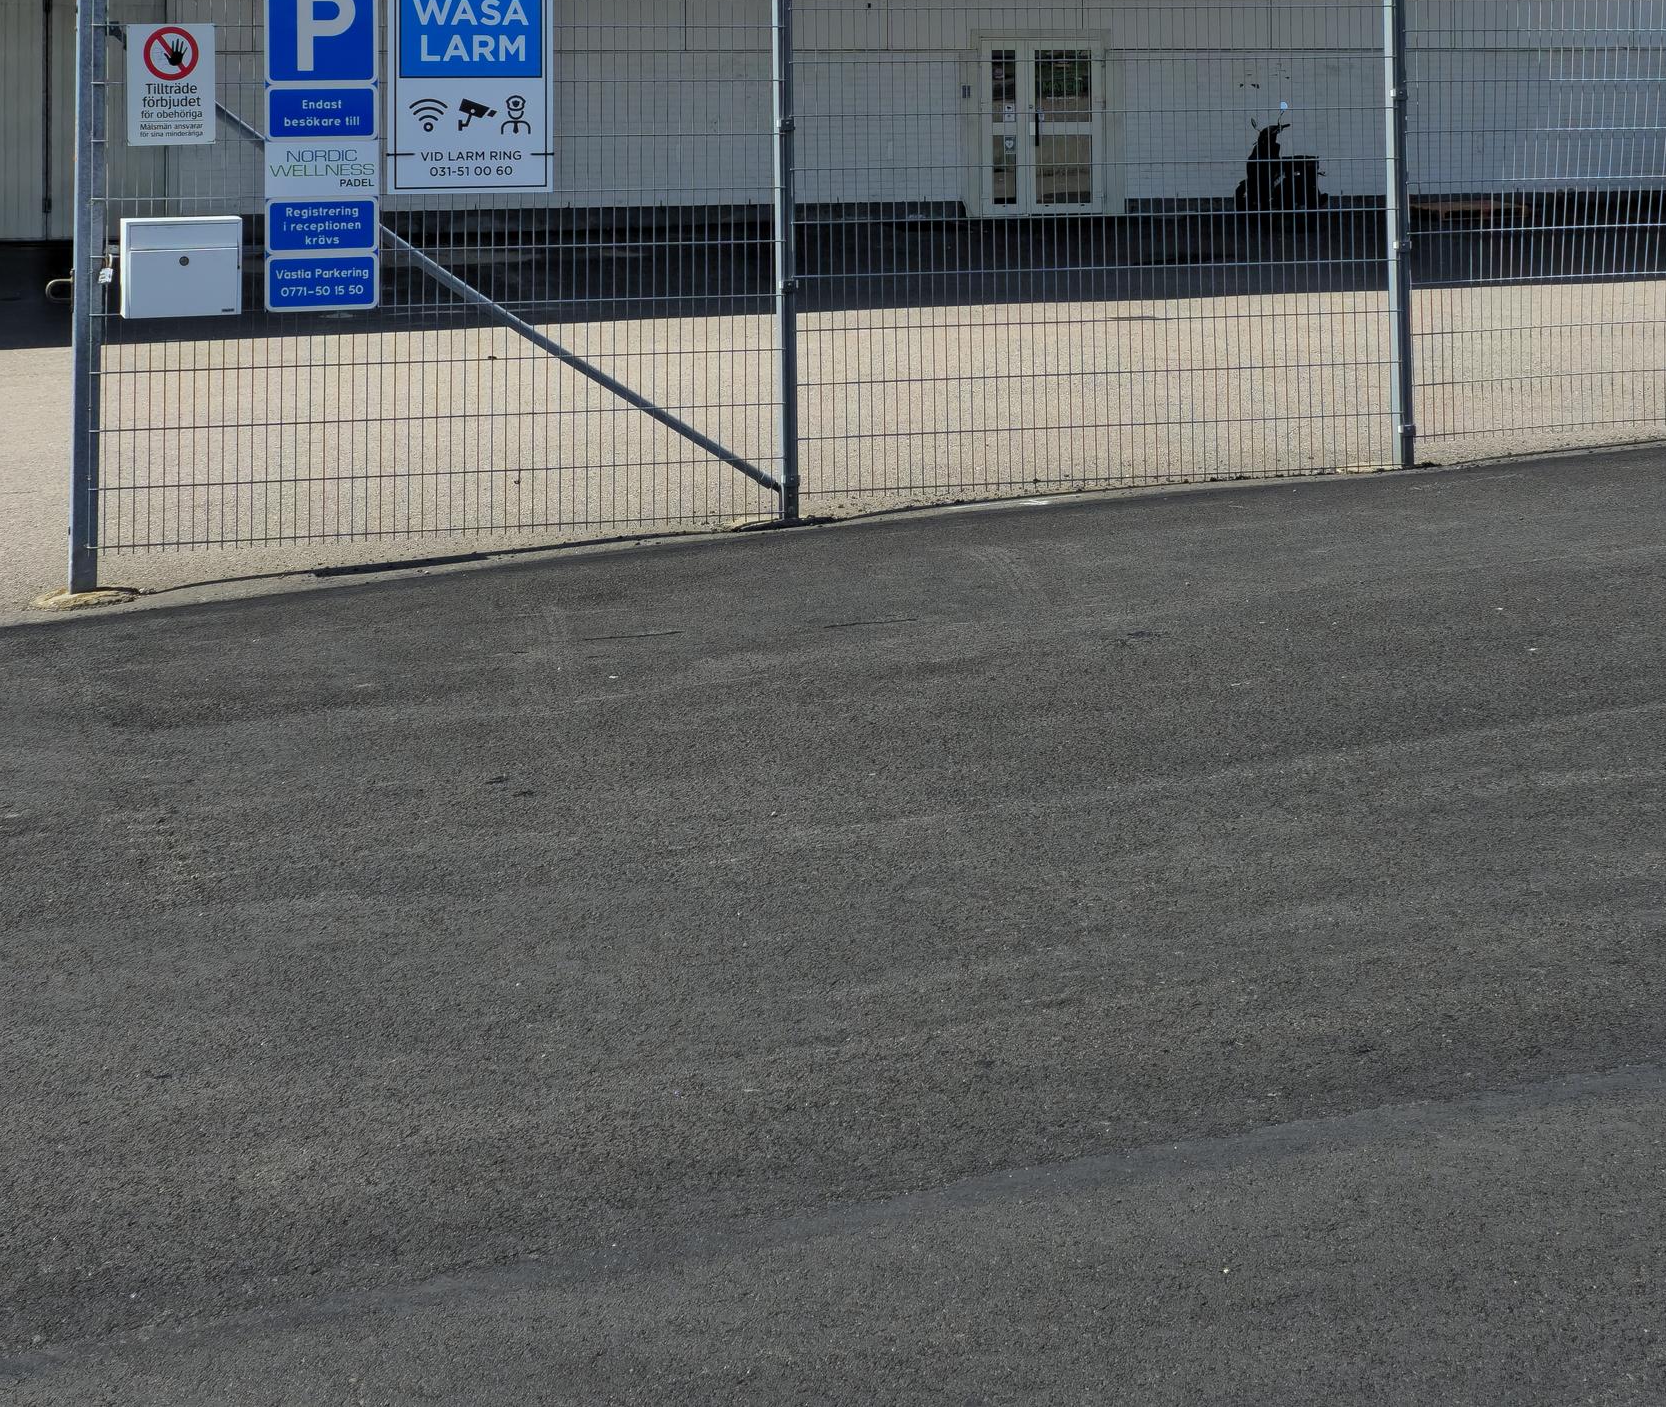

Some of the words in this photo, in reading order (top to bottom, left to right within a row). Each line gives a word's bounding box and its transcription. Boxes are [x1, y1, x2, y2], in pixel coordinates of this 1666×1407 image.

[420, 34, 526, 62] LARM
[145, 82, 198, 95] Tillträde
[142, 96, 202, 110] förbjudet
[302, 99, 342, 110] Endast
[141, 110, 154, 119] för
[156, 109, 203, 120] obehöriga
[284, 116, 341, 127] besökare
[345, 115, 360, 126] till
[140, 122, 172, 131] Målsmän
[174, 122, 204, 131] ansvarar
[286, 149, 358, 163] NORDIC
[420, 151, 444, 162] VID
[448, 151, 485, 162] LARM
[489, 150, 522, 161] RING
[269, 163, 375, 177] WELLNESS
[429, 166, 470, 177] 031-51
[474, 166, 492, 176] 00
[496, 165, 513, 176] 60
[339, 178, 375, 188] PADEL
[285, 205, 359, 219] Registrering
[283, 221, 287, 232] i
[290, 220, 362, 233] receptionen
[305, 235, 340, 245] krävs
[315, 267, 370, 280] Parkering
[280, 285, 331, 297] 0771-50
[334, 285, 345, 296] 15
[348, 284, 364, 295] 50
